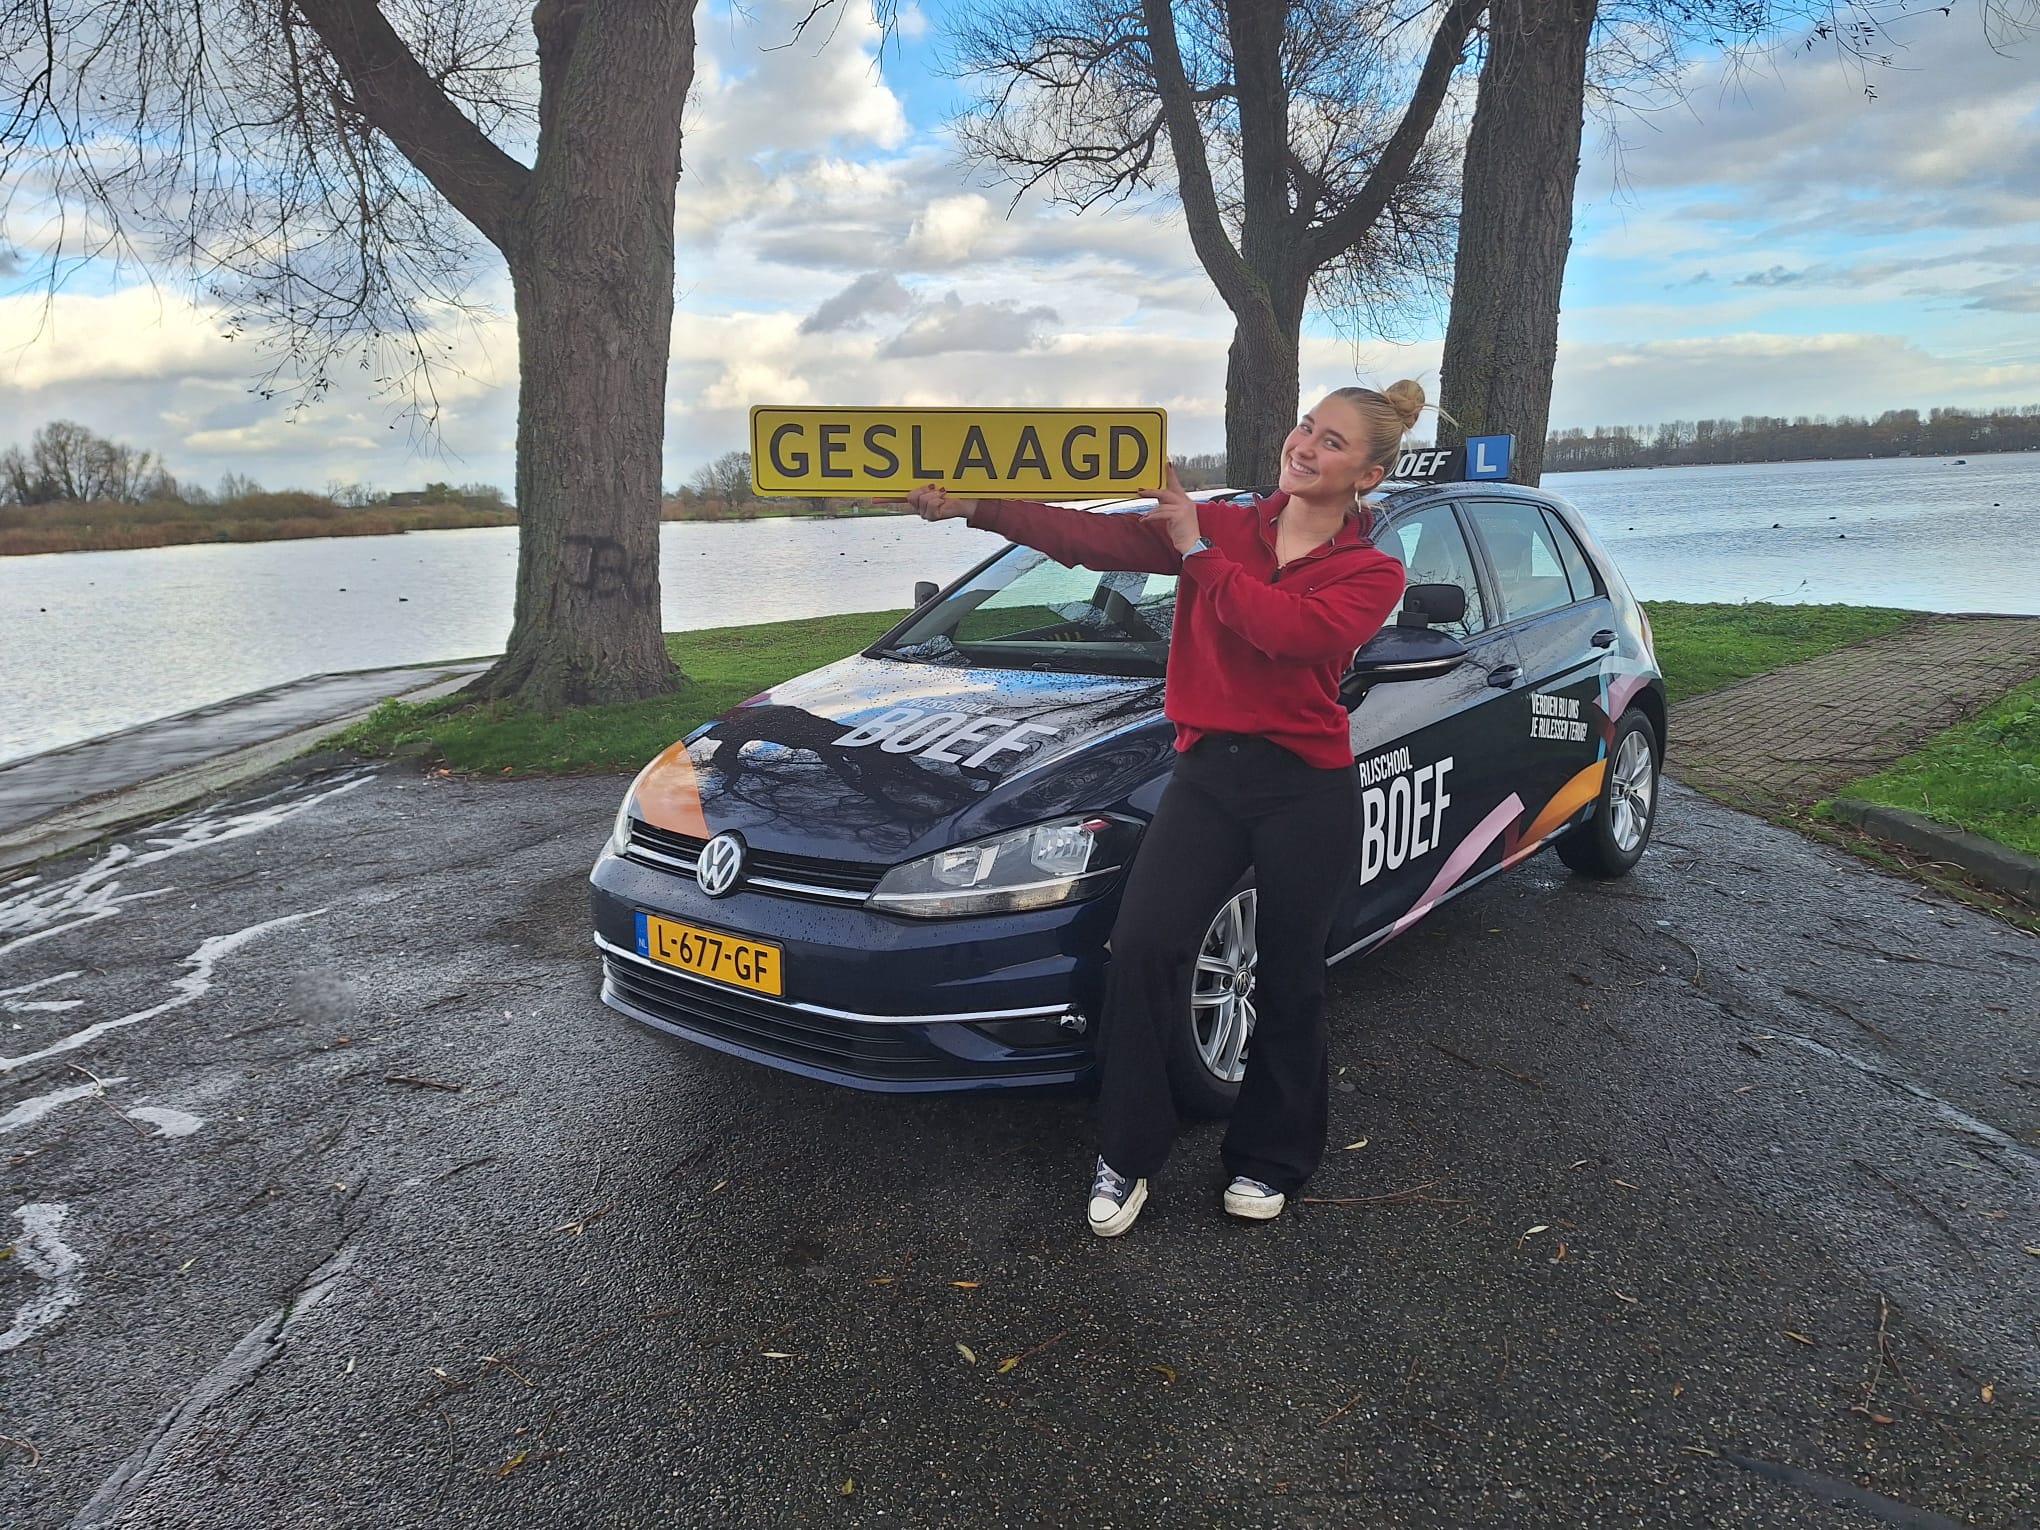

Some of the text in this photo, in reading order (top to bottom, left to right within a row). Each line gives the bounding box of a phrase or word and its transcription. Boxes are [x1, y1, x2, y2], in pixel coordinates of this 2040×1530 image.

[769, 423, 1149, 480] GESLAAGD
[1388, 451, 1452, 478] OEF
[1476, 443, 1497, 473] L
[1531, 692, 1580, 720] VERDIEN BIJ ONS
[831, 707, 1060, 769] BOEF
[1530, 716, 1588, 742] JE RIJLESSEN TERUG!
[1359, 746, 1413, 788] RIJSCHOOL
[1359, 756, 1454, 886] BOEF
[638, 925, 768, 984] NL L-677-GF
